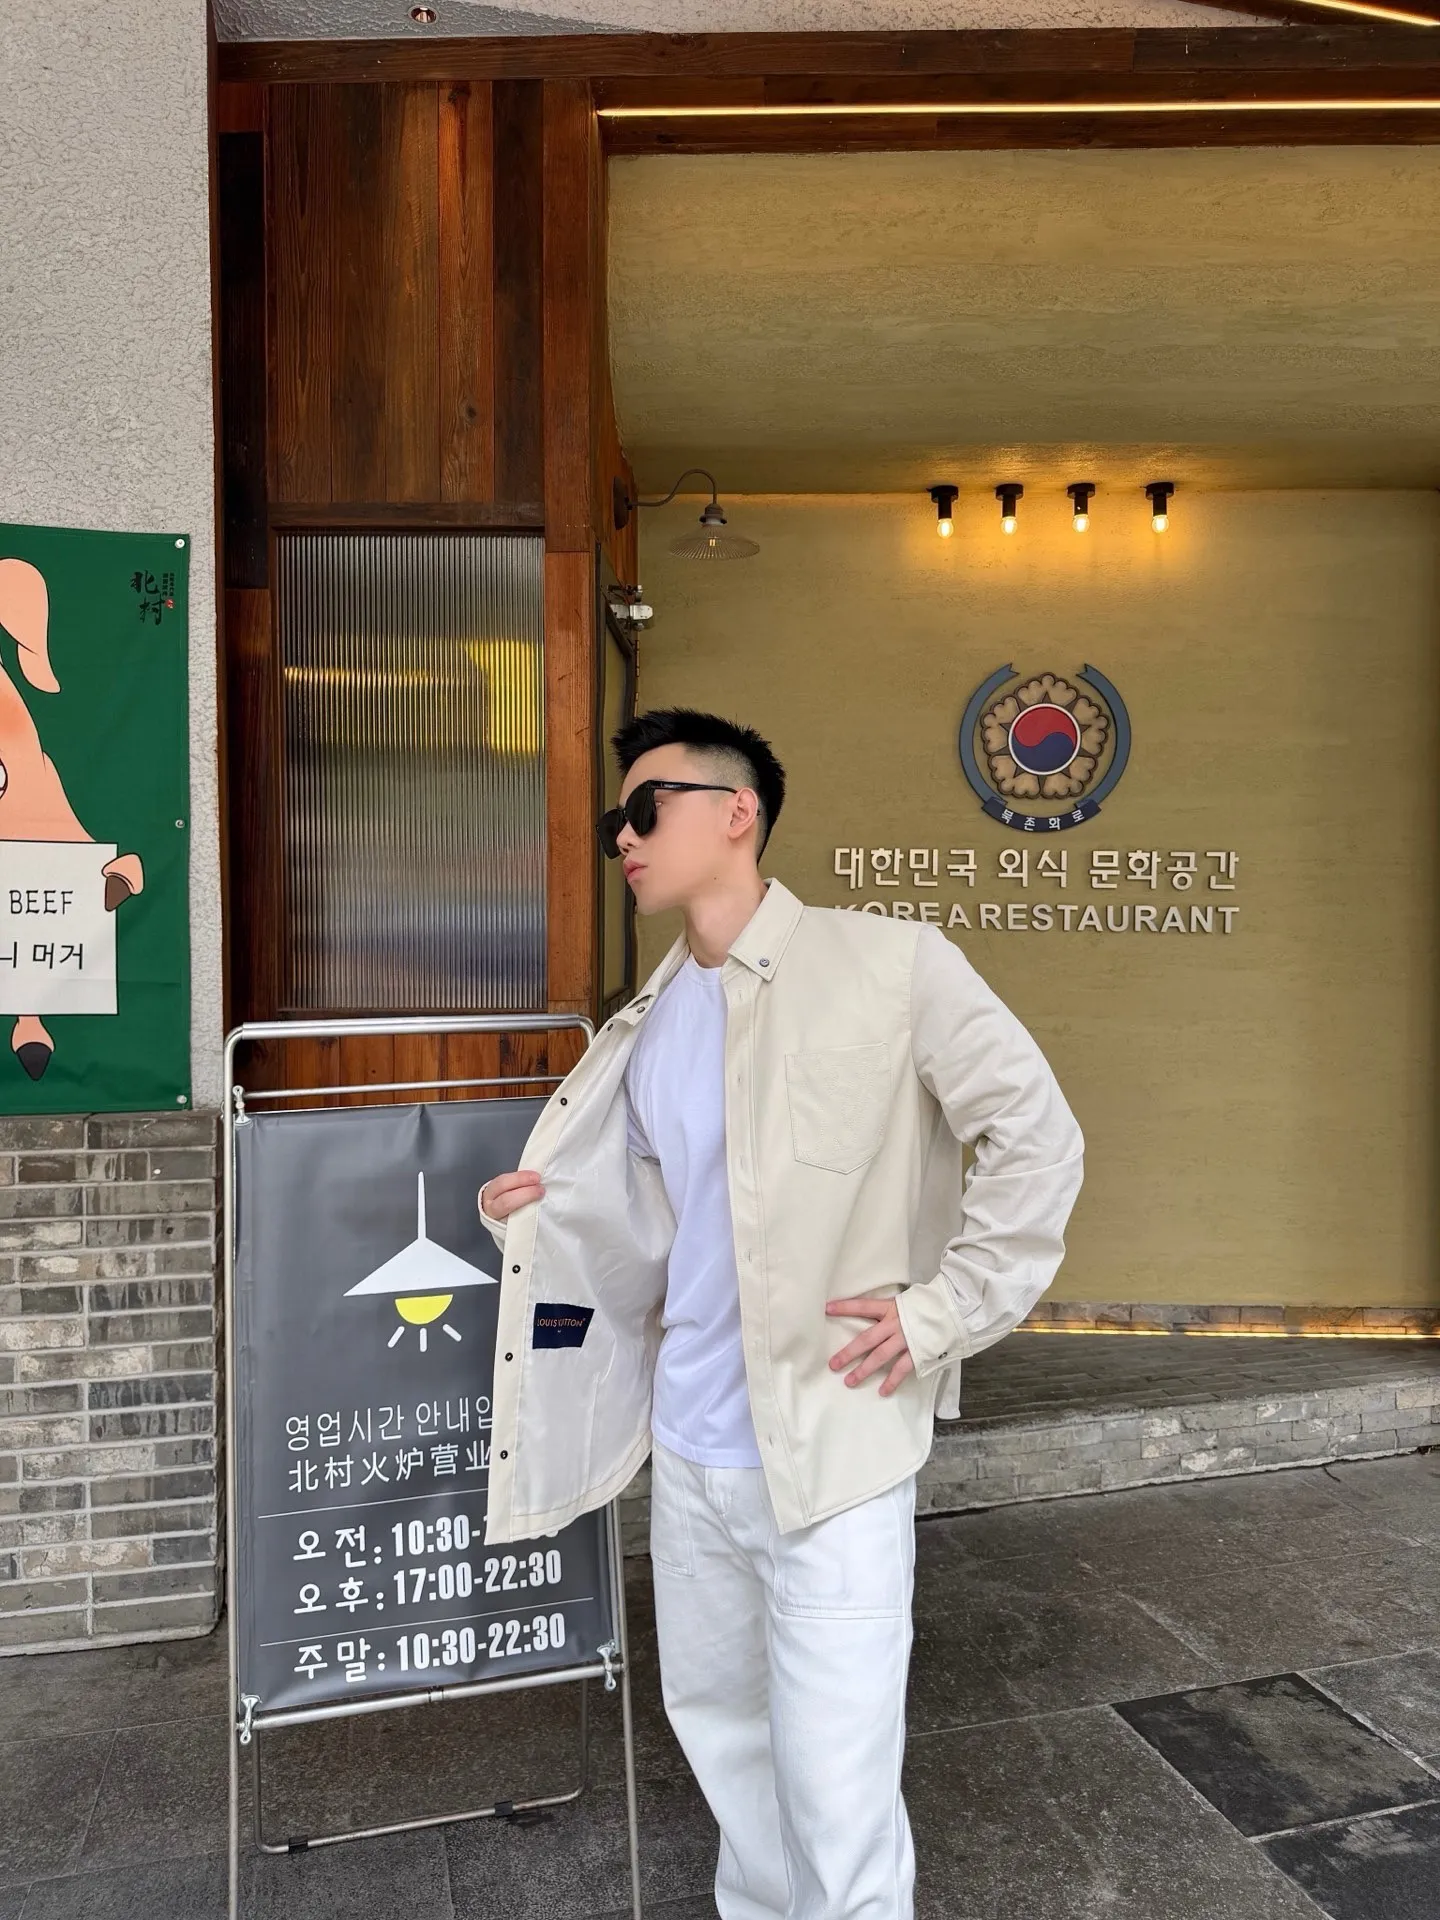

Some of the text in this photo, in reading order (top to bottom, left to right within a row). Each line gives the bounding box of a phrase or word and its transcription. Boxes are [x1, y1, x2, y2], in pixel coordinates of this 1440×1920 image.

[834, 847, 1240, 890] 대한민국 외식 문화공간
[9, 889, 73, 915] BEEF
[834, 901, 1240, 933] OREA RESTAURANT
[32, 942, 83, 970] 머거
[285, 1404, 405, 1452] 영업시간
[393, 1549, 562, 1606] 17:00-22:30
[396, 1612, 566, 1672] 10:30-22:30
